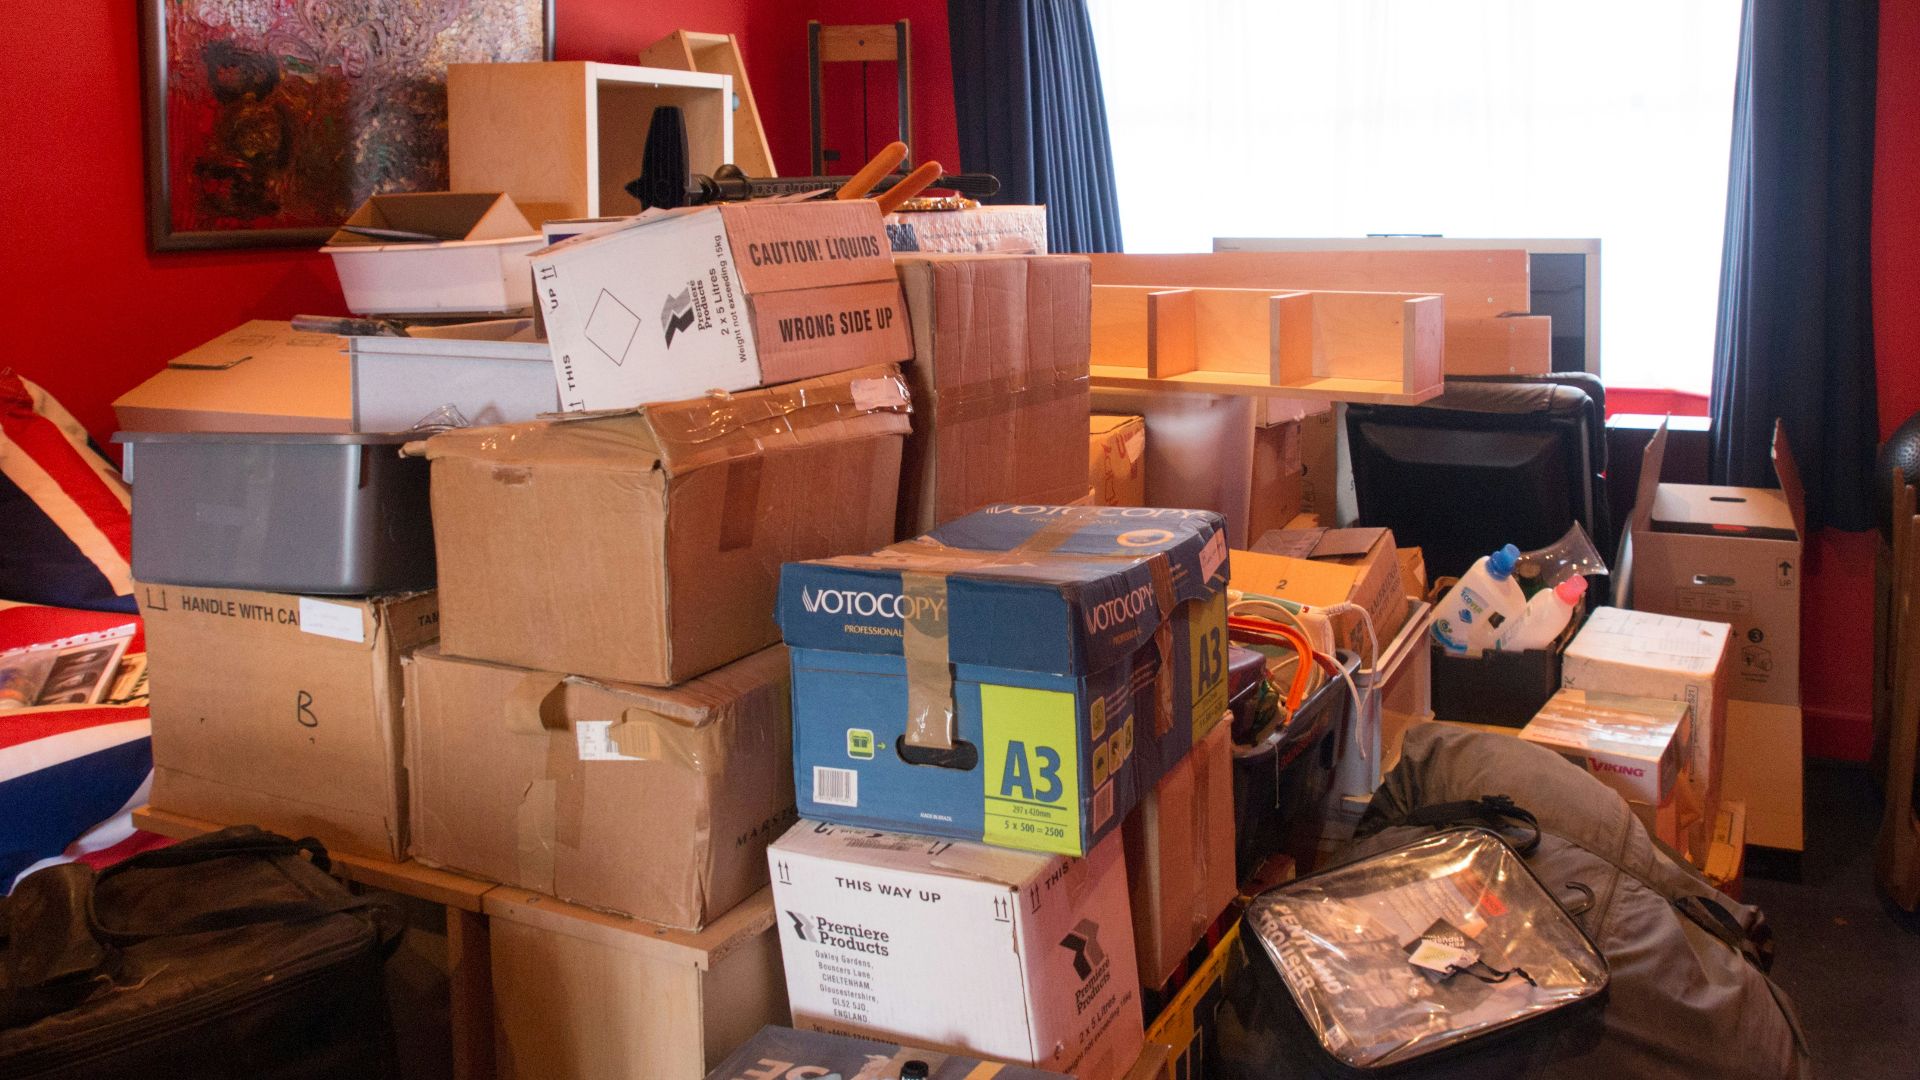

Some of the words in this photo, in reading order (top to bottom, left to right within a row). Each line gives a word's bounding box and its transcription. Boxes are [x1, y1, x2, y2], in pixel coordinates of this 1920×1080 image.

[714, 234, 723, 258] 15kg
[749, 238, 824, 267] CAUTION!
[825, 235, 880, 262] LIQUIDS
[548, 288, 559, 309] UP
[709, 268, 722, 304] Litres
[720, 260, 735, 309] exceeding
[690, 280, 706, 331] Premiere
[697, 280, 713, 329] Products
[730, 311, 738, 326] not
[721, 328, 730, 336] 2
[778, 312, 835, 343] WRONG
[839, 309, 873, 335] SIDE
[876, 306, 893, 330] UP
[735, 329, 747, 363] Weight
[563, 354, 576, 391] THIS
[1276, 579, 1288, 590] 2
[181, 595, 235, 617] HANDLE
[239, 603, 274, 622] WITH
[802, 584, 945, 621] VOTOCOPY
[1085, 582, 1154, 635] VOTOCOPY
[844, 624, 904, 637] PROFESSIONAL
[1198, 626, 1222, 697] A3
[297, 690, 318, 727] B
[1000, 739, 1063, 803] A3
[1588, 757, 1646, 778] VIKING
[1012, 805, 1023, 815] 297
[1029, 807, 1052, 818] 420mm
[1004, 820, 1009, 829] 5
[1020, 822, 1035, 833] 500
[1044, 825, 1064, 838] 2500
[835, 876, 872, 892] THIS
[878, 884, 912, 899] WAY
[919, 890, 942, 903] UP
[1045, 862, 1069, 890] THIS
[816, 916, 890, 942] Premiere
[819, 931, 889, 957] Products
[815, 949, 839, 963] Oakley
[818, 961, 851, 975] Bouncers
[1260, 910, 1316, 994] TROUSER
[1074, 958, 1110, 1002] Premiere
[1076, 972, 1111, 1015] Products
[1079, 1032, 1085, 1045] 2
[1091, 1018, 1097, 1030] 5
[1098, 995, 1117, 1024] Litres
[1094, 1006, 1120, 1043] exceeding
